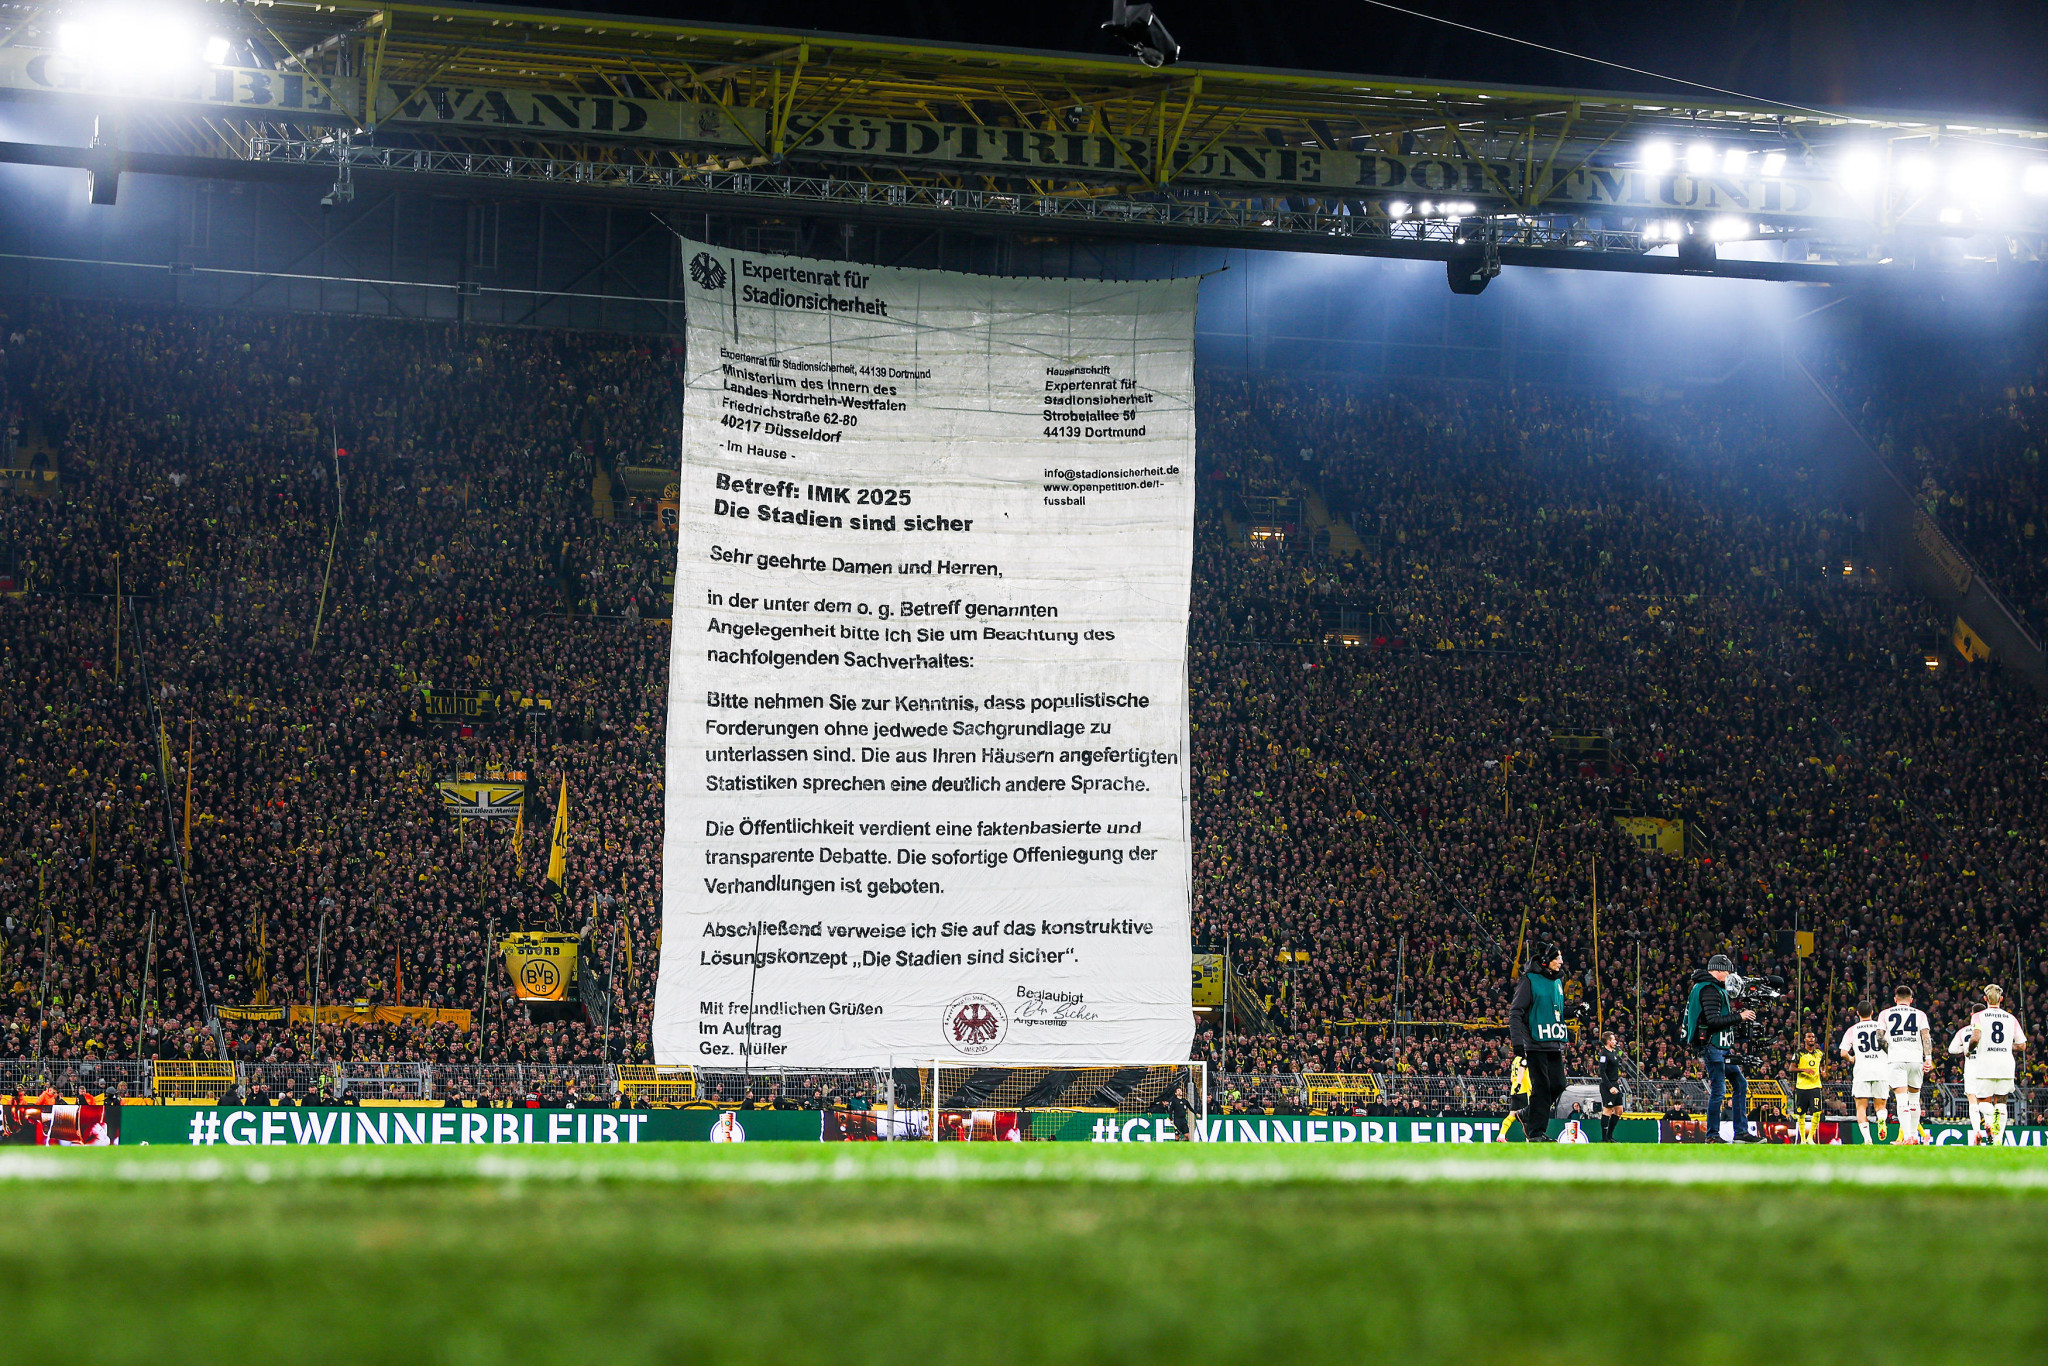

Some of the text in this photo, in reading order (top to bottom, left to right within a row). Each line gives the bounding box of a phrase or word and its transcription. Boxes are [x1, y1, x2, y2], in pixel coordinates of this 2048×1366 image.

[387, 84, 648, 134] WAND
[785, 111, 1812, 212] SÜDTRIBÜNE DORTMUND
[743, 260, 869, 288] Expertenrat für
[743, 285, 887, 317] Stadionsicherheit
[720, 345, 931, 379] Expertenrat für Stadionsicherheit, 44139 Dortmund
[723, 364, 896, 396] Ministerium des Innern des
[1045, 379, 1137, 393] Expertenrat für
[724, 379, 906, 411] Landes Nordrhein-Westfalen
[1044, 393, 1153, 405] Stadionsicherheit
[722, 397, 857, 426] Friedrichstraße 62-80
[1043, 410, 1119, 422] Strobelallee
[721, 414, 842, 442] 40217 Düsseldorf
[1043, 425, 1145, 437] 44139 Dortmund
[728, 440, 786, 459] Im Hause
[1045, 465, 1179, 481] info@stadionsicherheit.de
[716, 473, 911, 505] Betreff: IMK 2025
[1044, 496, 1085, 505] fussball
[714, 499, 973, 531] Die Stadien sind sicher
[710, 545, 1002, 578] Sehr geehrte Damen und Herren,
[708, 590, 1057, 620] in der unter dem o. g. Betreff genannten
[707, 618, 836, 640] Angelegenheit
[841, 625, 879, 640] bitte
[917, 628, 944, 642] Sie
[950, 630, 977, 640] um
[984, 627, 1078, 645] Beachtung
[1084, 629, 1115, 640] des
[708, 649, 973, 669] nachfolgenden Sachverhaltes:
[708, 692, 1149, 713] Bitte nehmen Sie zur Kenntnis, dass populistische
[706, 720, 1111, 740] Forderungen ohne jedwede Sachgrundlage zu
[706, 746, 1177, 767] unterlassen sind. Die aus Ihren Häusern angefertigten
[707, 775, 1149, 794] Statistiken sprechen eine deutlich andere Sprache.
[706, 817, 1141, 836] Die Öffentlichkeit verdient eine faktenbasierte und
[1636, 833, 1657, 849] 11
[705, 846, 1158, 868] transparente Debatte. Die sofortige Offenlegung der
[704, 875, 943, 898] Verhandlungen ist geboten.
[703, 920, 821, 937] Abschließend
[827, 924, 906, 938] verweise
[941, 922, 968, 937] Sie
[973, 921, 1000, 936] auf
[1004, 920, 1036, 936] das
[1042, 919, 1153, 934] konstruktive
[701, 949, 847, 968] Lösungskonzept
[896, 950, 961, 966] Stadien
[967, 949, 1004, 965] sind
[526, 963, 554, 985] BVB
[535, 984, 547, 992] 09
[1017, 986, 1083, 1007] Beglaubigt
[701, 1002, 882, 1015] Mit freundlichen Grüßen
[699, 1021, 782, 1038] Im Auftrag
[1888, 1013, 1918, 1036] 24
[1991, 1021, 2005, 1044] 8
[700, 1042, 787, 1055] Gez. Müller
[1858, 1031, 1881, 1052] 30
[189, 1112, 648, 1145] #GEWINNERBLEIBT
